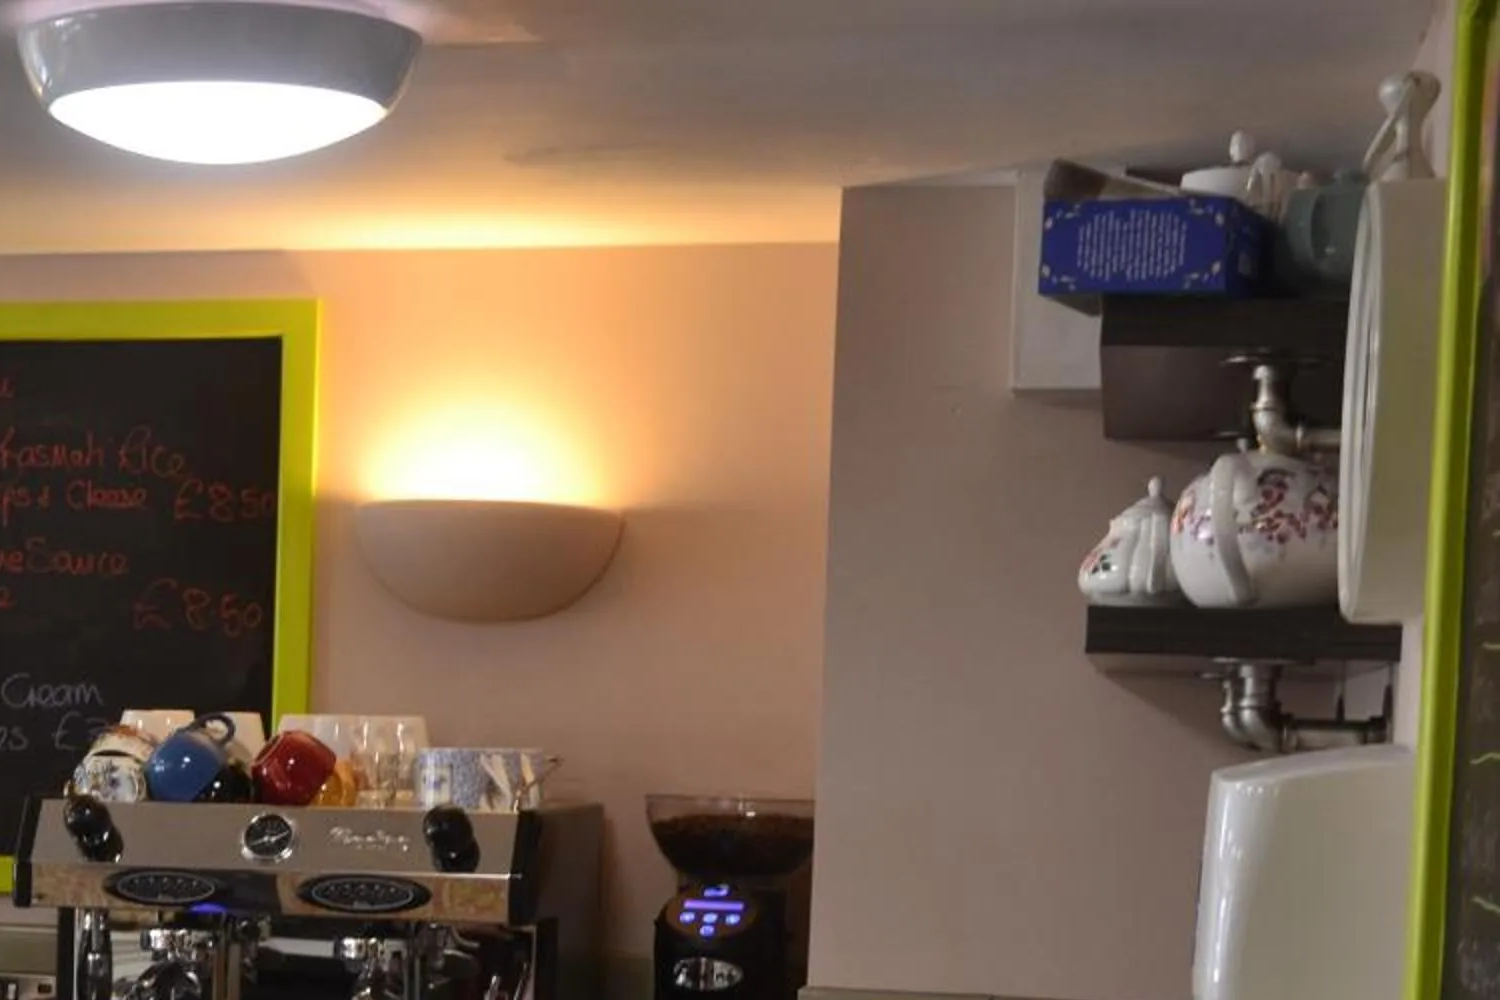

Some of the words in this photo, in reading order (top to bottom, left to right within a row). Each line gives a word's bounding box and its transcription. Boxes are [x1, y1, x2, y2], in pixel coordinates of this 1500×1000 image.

[117, 423, 188, 481] Rice
[66, 479, 149, 512] Cheese
[24, 535, 131, 579] Sauce
